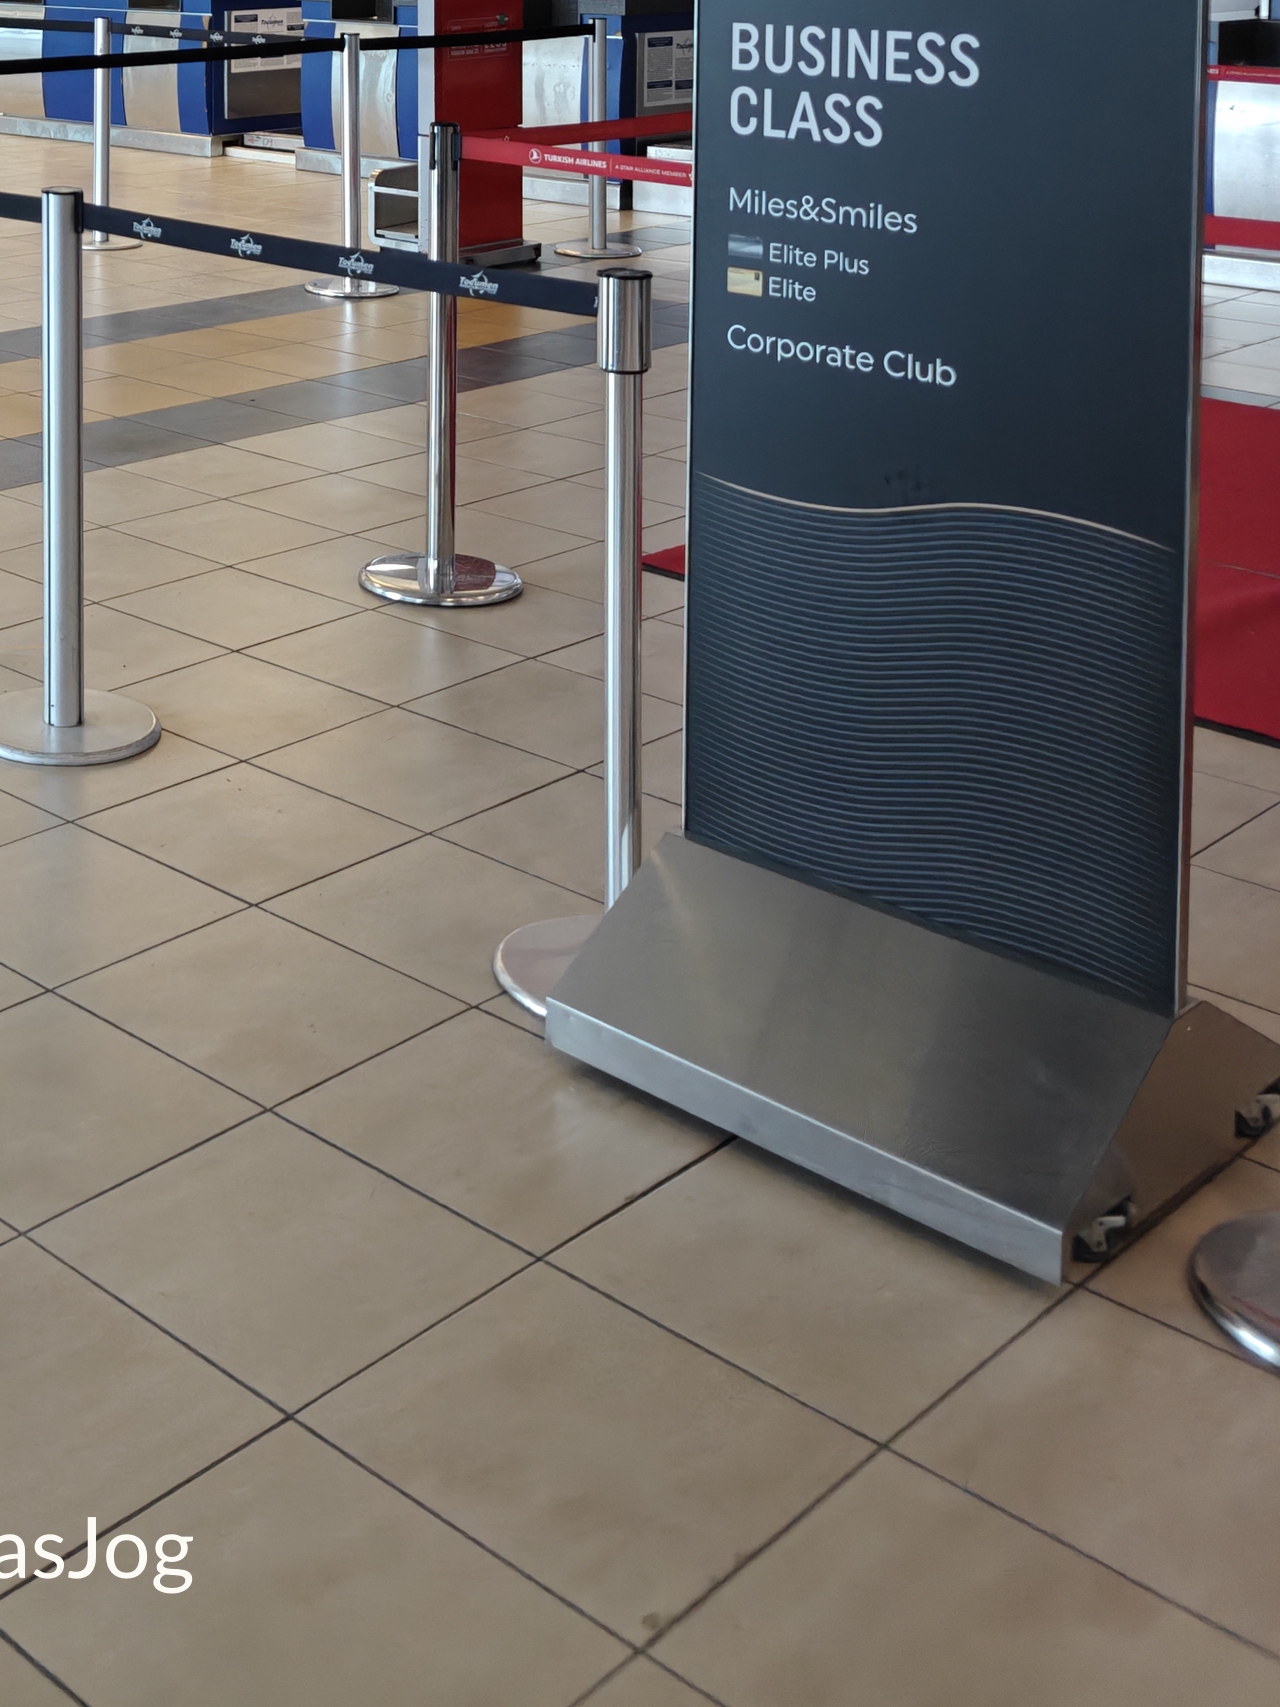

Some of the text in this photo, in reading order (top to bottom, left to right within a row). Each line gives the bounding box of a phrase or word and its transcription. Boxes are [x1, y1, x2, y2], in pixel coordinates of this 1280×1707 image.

[731, 22, 980, 87] BUSINESS
[730, 85, 883, 147] CLASS
[543, 154, 607, 169] TURKISH AIRLINES
[729, 186, 918, 234] Miles&Smiles
[338, 256, 374, 270] Tocumen
[769, 242, 869, 275] Elite Plus
[459, 275, 499, 290] Tocumen
[769, 276, 816, 302] Elite
[727, 324, 957, 387] Corporate Club
